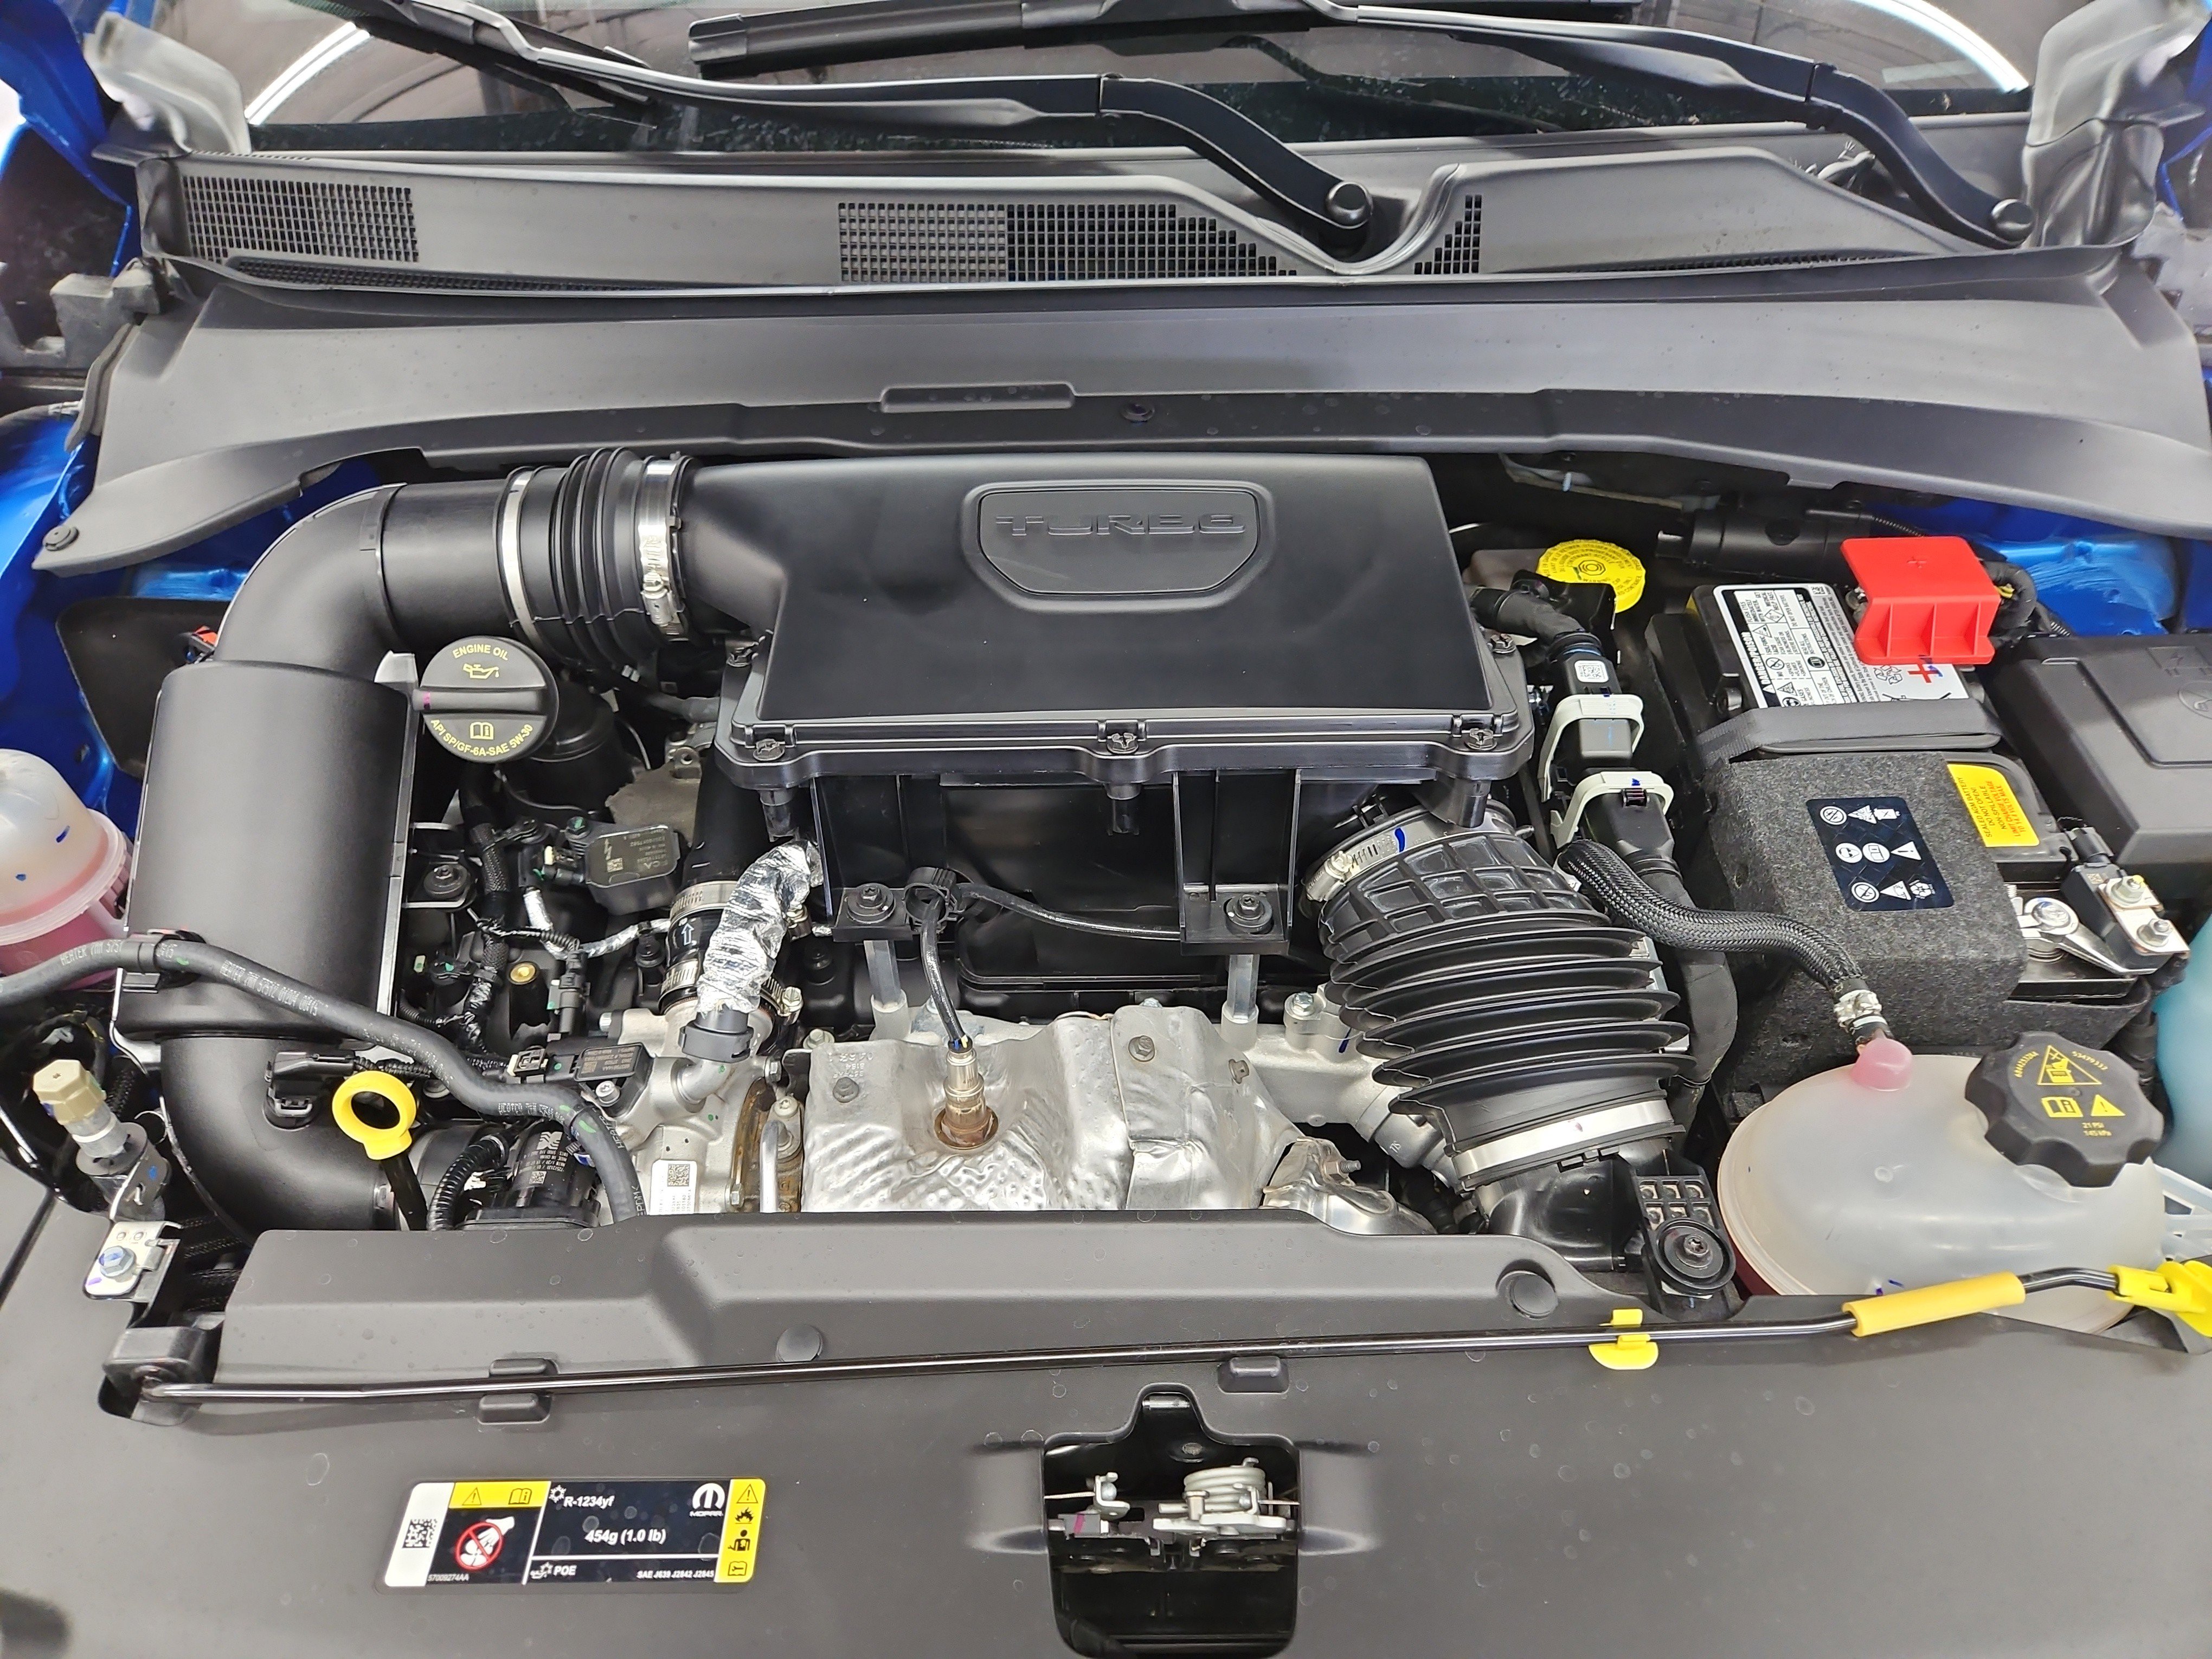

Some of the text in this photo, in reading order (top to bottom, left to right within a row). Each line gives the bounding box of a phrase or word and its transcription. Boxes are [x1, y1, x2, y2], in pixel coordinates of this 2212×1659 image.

[995, 515, 1245, 536] TURBO
[452, 644, 509, 661] ENGINE OIL
[1739, 632, 1772, 684] DANGER/POISON
[430, 718, 533, 757] API SP/GF-6A-SAE 5W-30
[1957, 777, 1992, 837] SEALED AGM BATTERY
[1979, 786, 2006, 829] NON-SPILLABLE
[1979, 806, 1990, 816] NOT
[1985, 781, 2021, 836] LIMIT CHARGE VOLTAGE
[599, 1115, 625, 1149] HEATER
[563, 1495, 615, 1510] R-1234yf
[584, 1529, 666, 1545] 454g (1.0 lb)
[553, 1565, 577, 1576] POE
[636, 1570, 653, 1578] SAE
